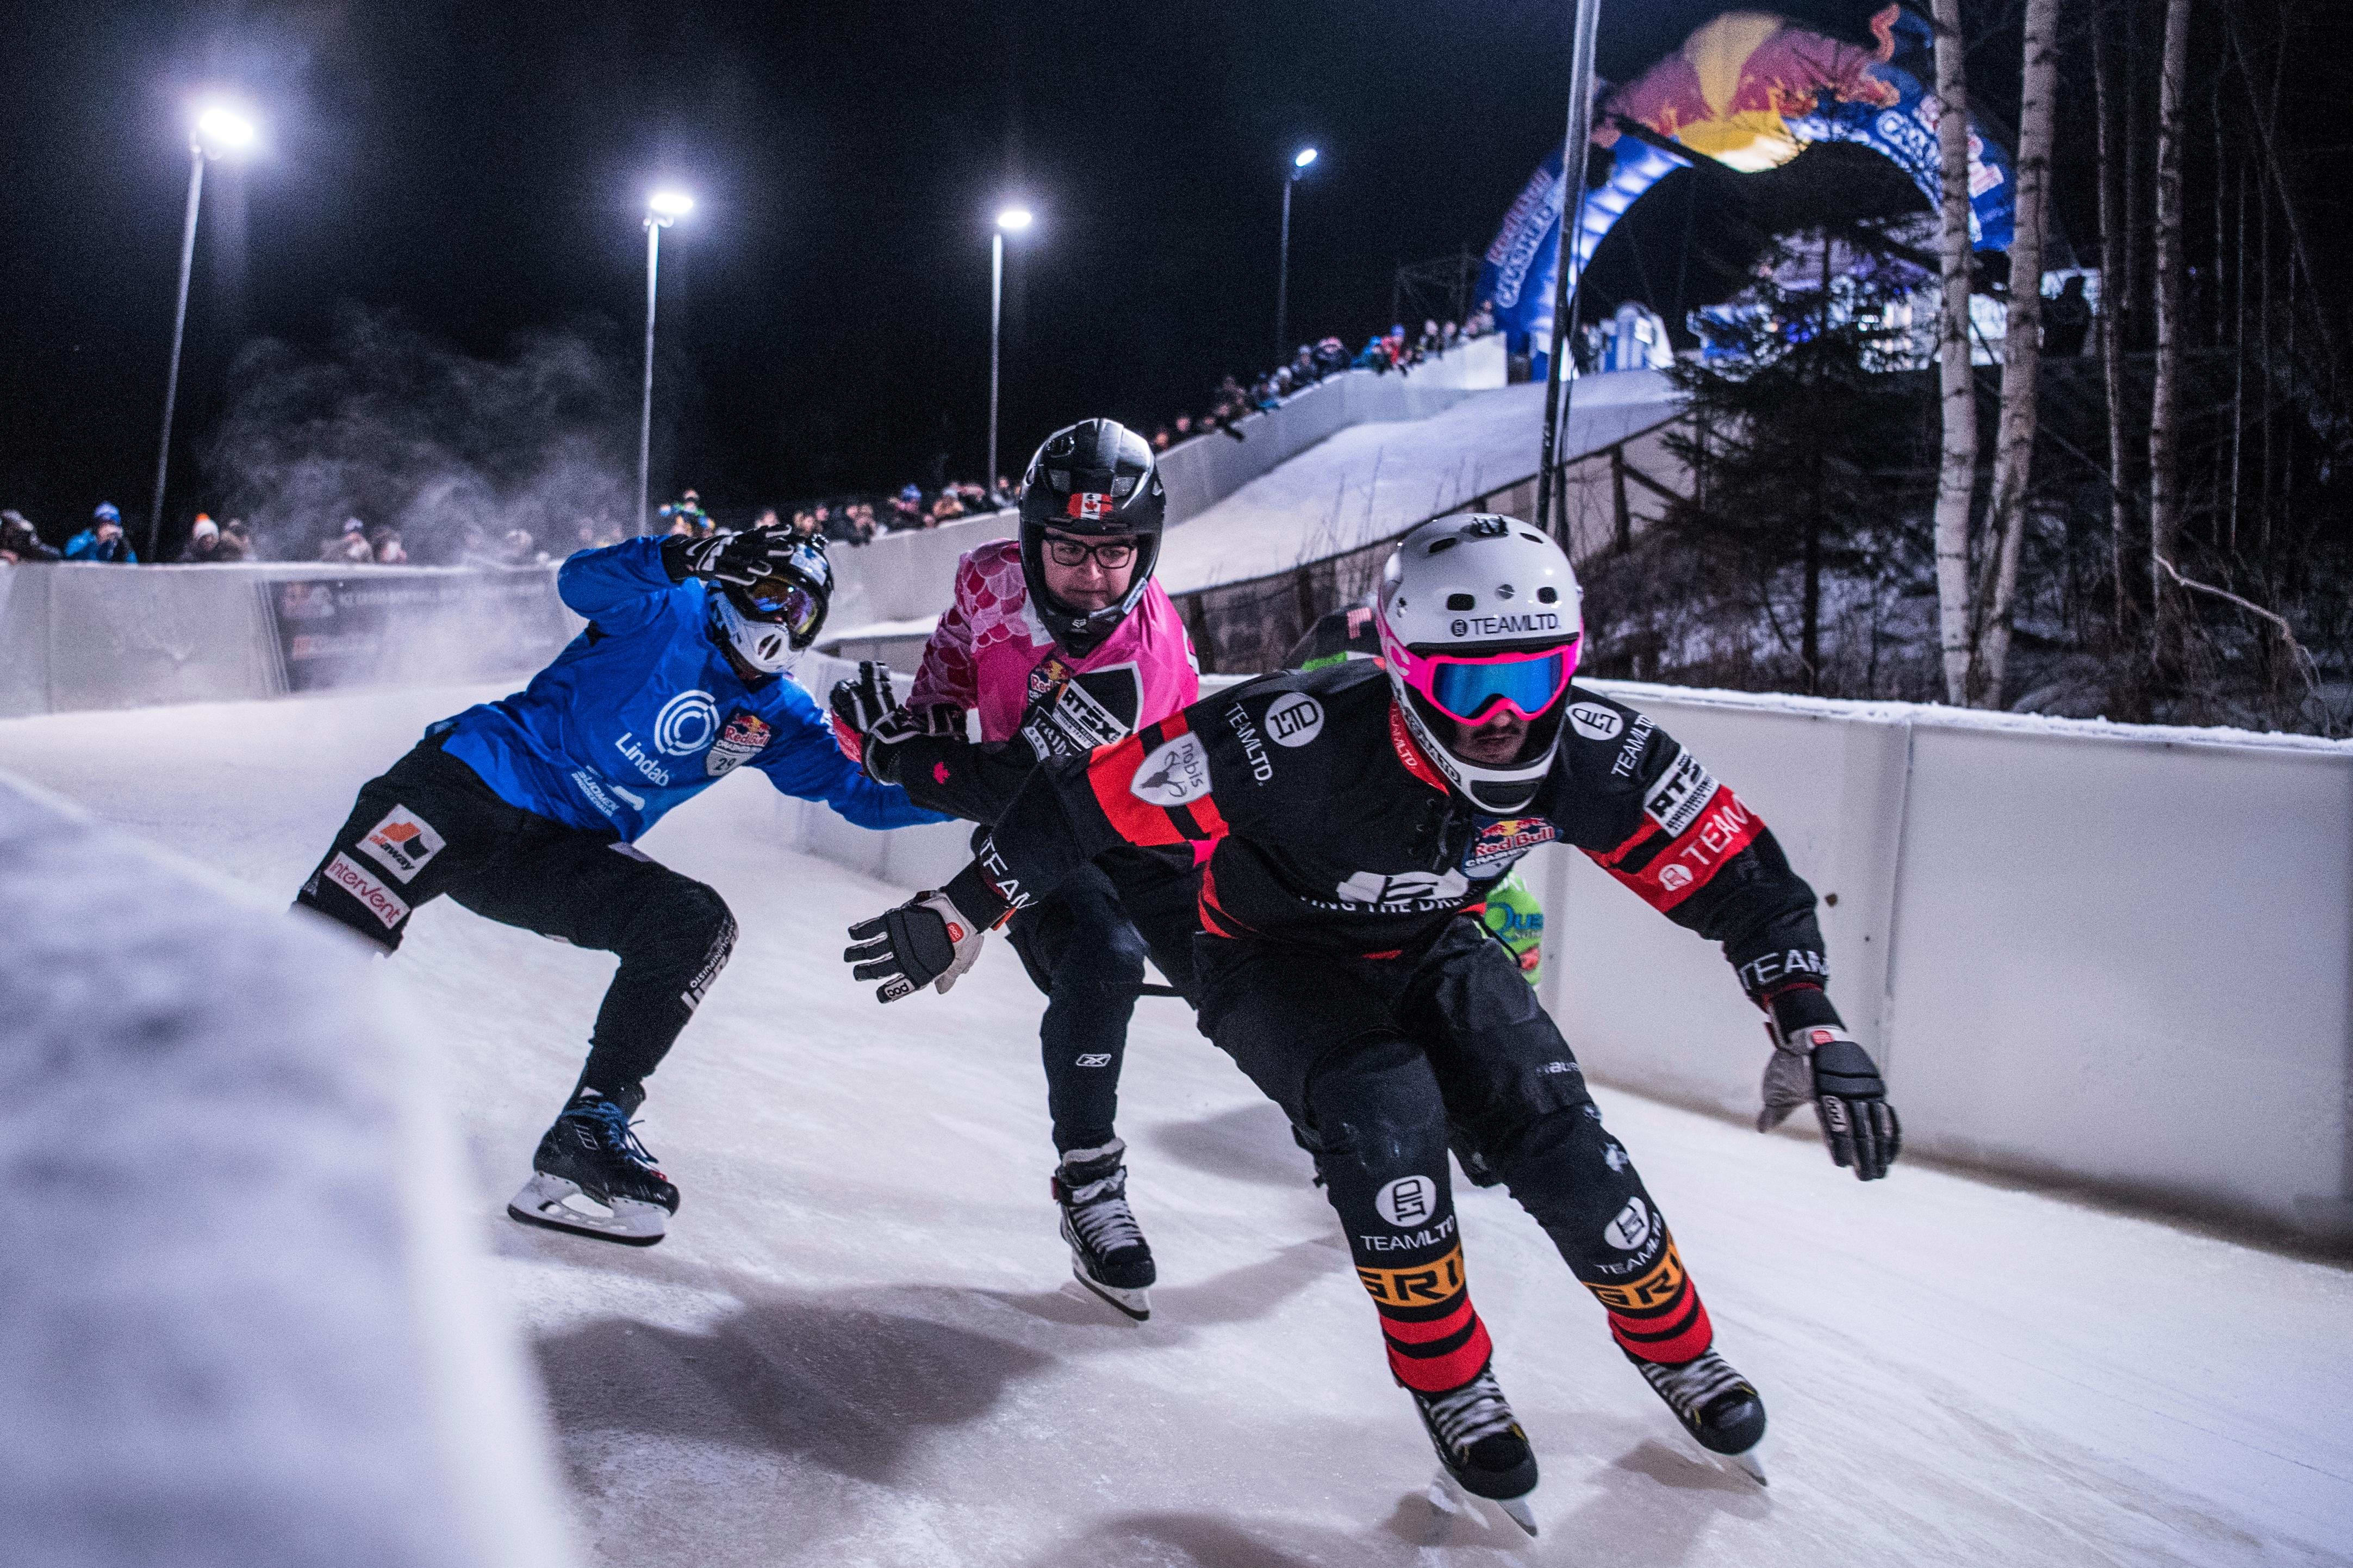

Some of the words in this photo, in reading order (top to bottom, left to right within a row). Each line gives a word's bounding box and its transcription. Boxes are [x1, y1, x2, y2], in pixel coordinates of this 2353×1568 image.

[1471, 613, 1560, 635] TEAMLTD
[724, 726, 749, 745] Red
[1225, 702, 1273, 784] TEAMLTD
[615, 732, 669, 787] Lindab
[714, 758, 736, 771] 29
[1181, 741, 1204, 789] nobis
[1476, 835, 1511, 857] Red
[1515, 826, 1555, 846] Bull
[1679, 795, 1756, 865] TEAM
[370, 835, 415, 871] allaway
[1360, 1213, 1454, 1251] TEAMLTD
